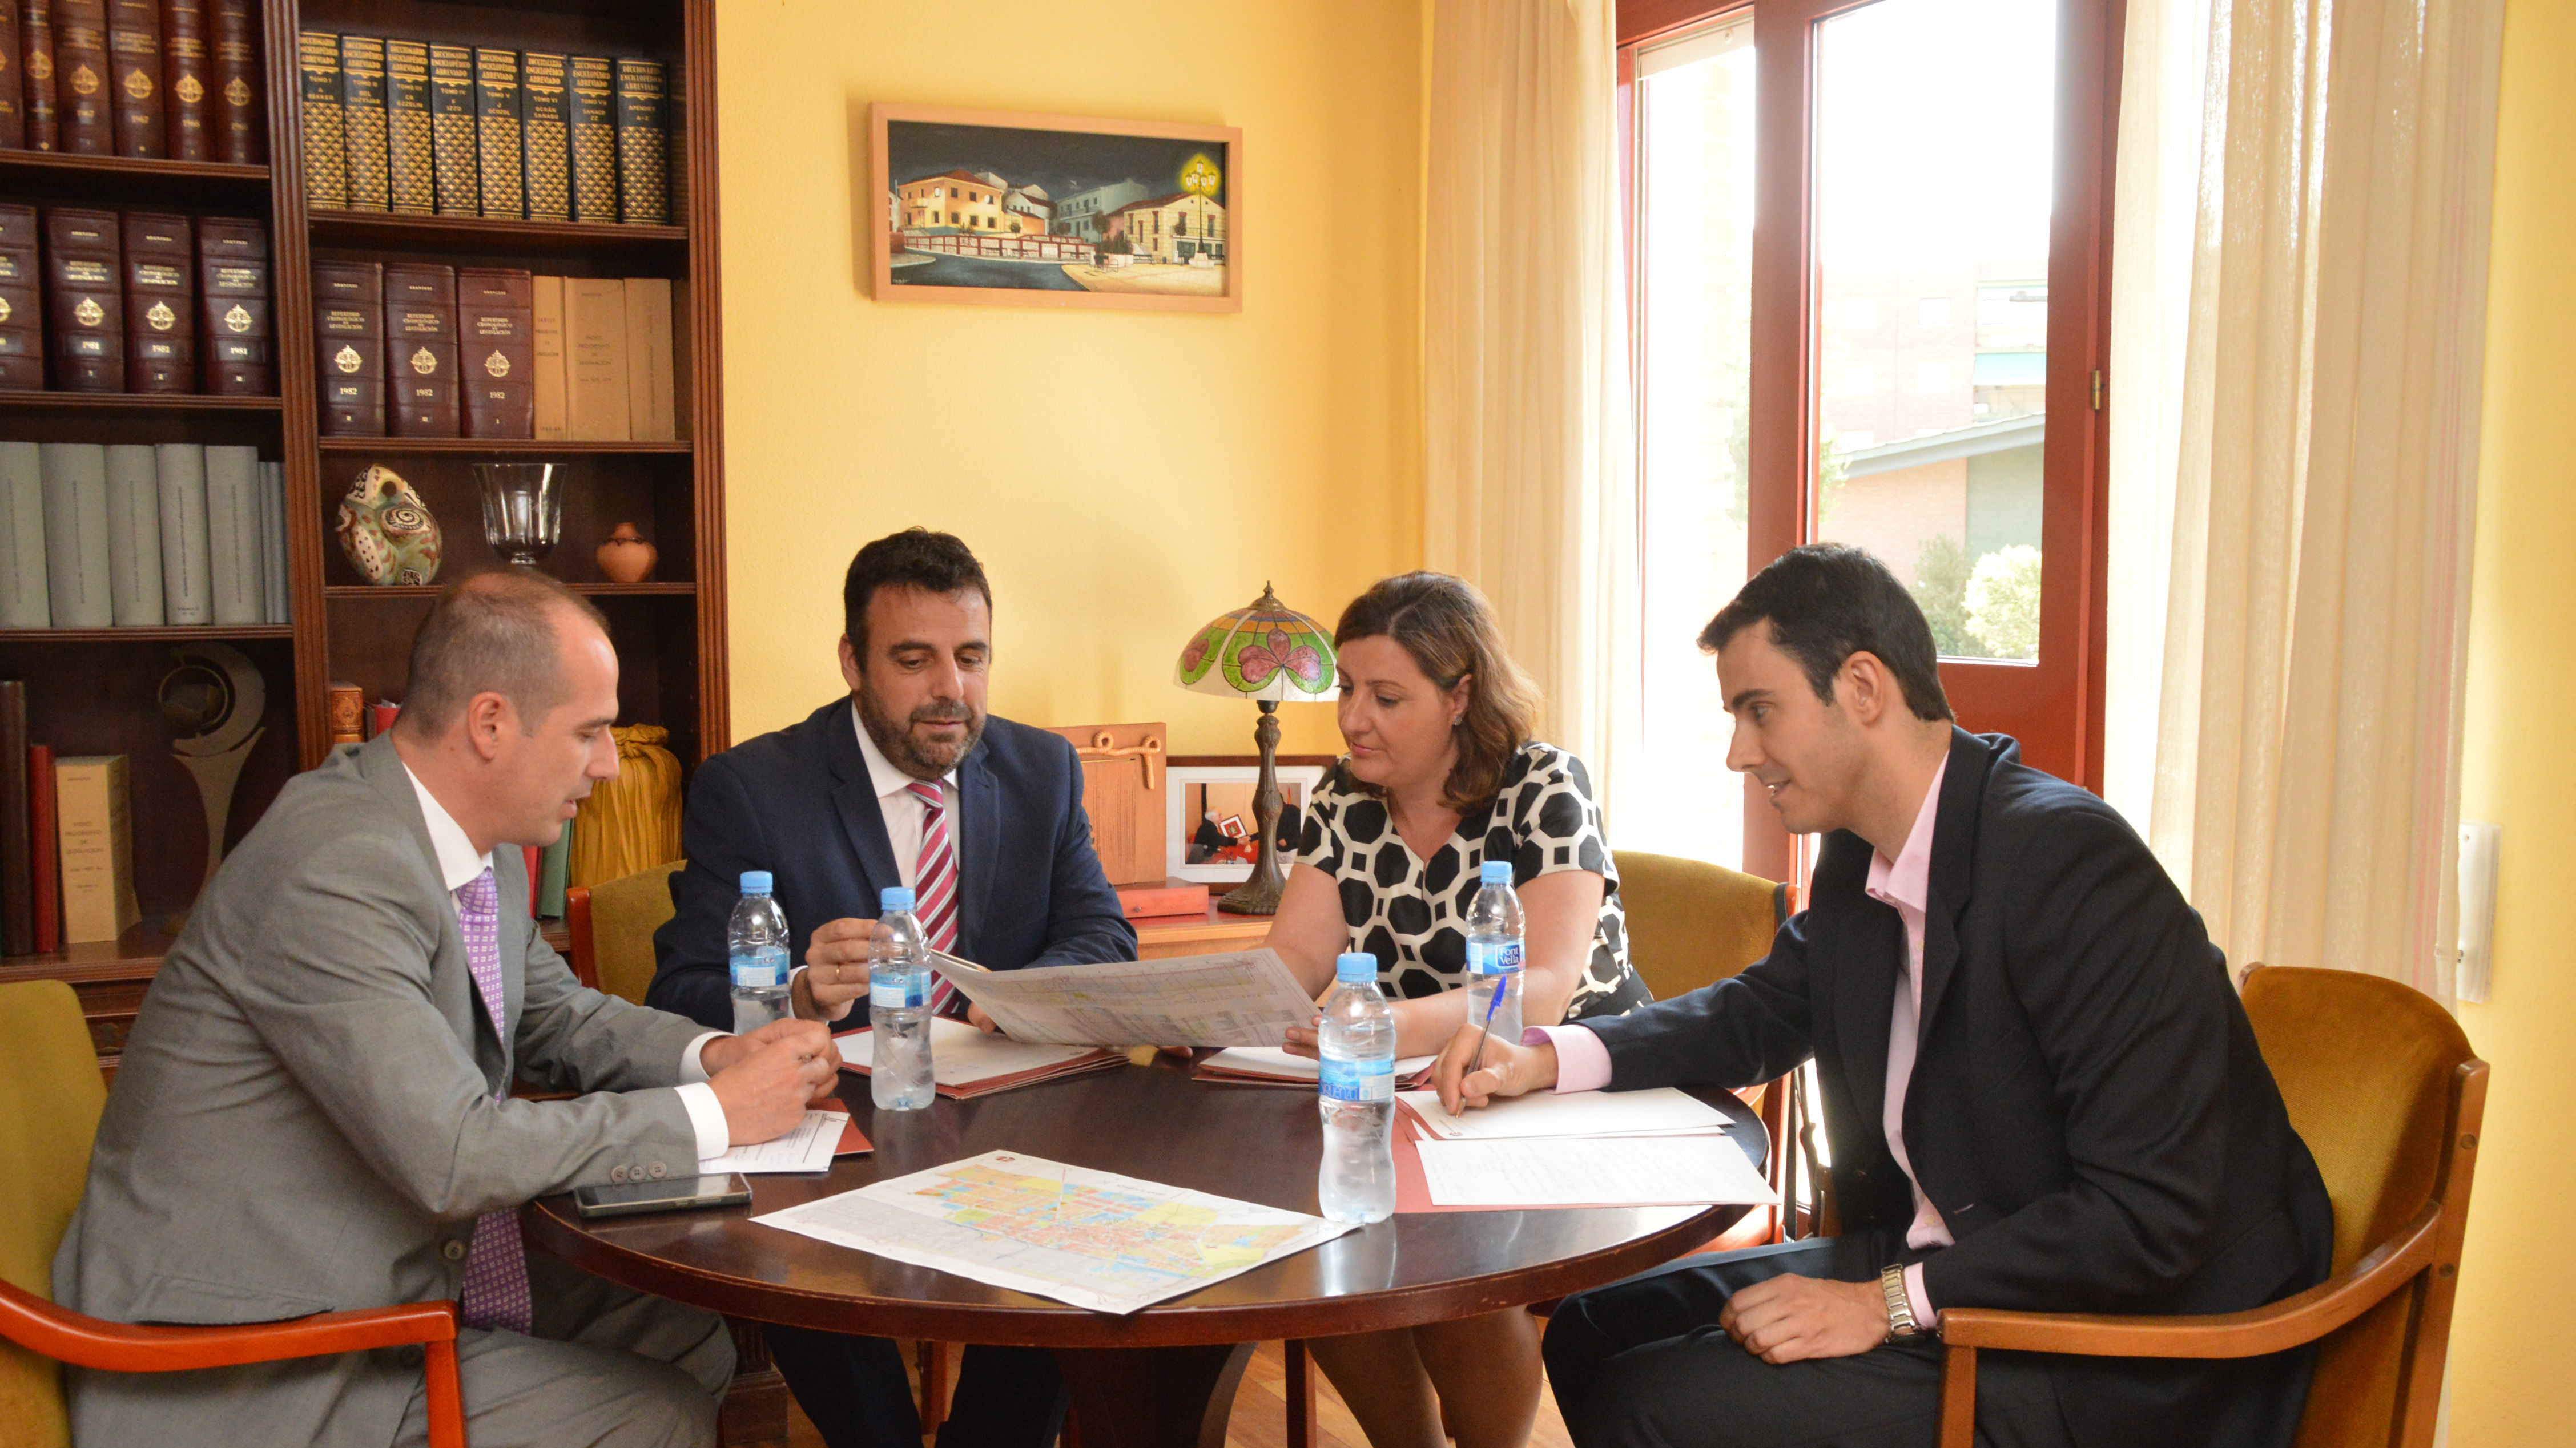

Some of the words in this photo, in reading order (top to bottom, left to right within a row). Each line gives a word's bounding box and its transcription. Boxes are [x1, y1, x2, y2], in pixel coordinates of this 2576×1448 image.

[345, 42, 382, 52] DICCIONARIO
[389, 45, 426, 55] DICCIONARIO
[301, 55, 336, 64] ABREVIADO
[433, 50, 468, 59] DICCIONARIO
[480, 54, 514, 64] DICCIONARIO
[347, 59, 381, 69] ABREVIADO
[392, 63, 425, 73] ABREVIADO
[528, 58, 562, 68] DICCIONARIO
[574, 62, 609, 71] DICCIONARIO
[435, 67, 468, 77] ABREVIADO
[622, 65, 659, 75] DICCIONARIO
[482, 71, 513, 81] ABREVIADO
[529, 75, 561, 85] ABREVIADO
[577, 79, 607, 88] ABREVIADO
[625, 82, 659, 91] ABREVIADO
[489, 391, 505, 400] 1982
[1500, 947, 1519, 957] Font
[1499, 955, 1519, 965] Vella
